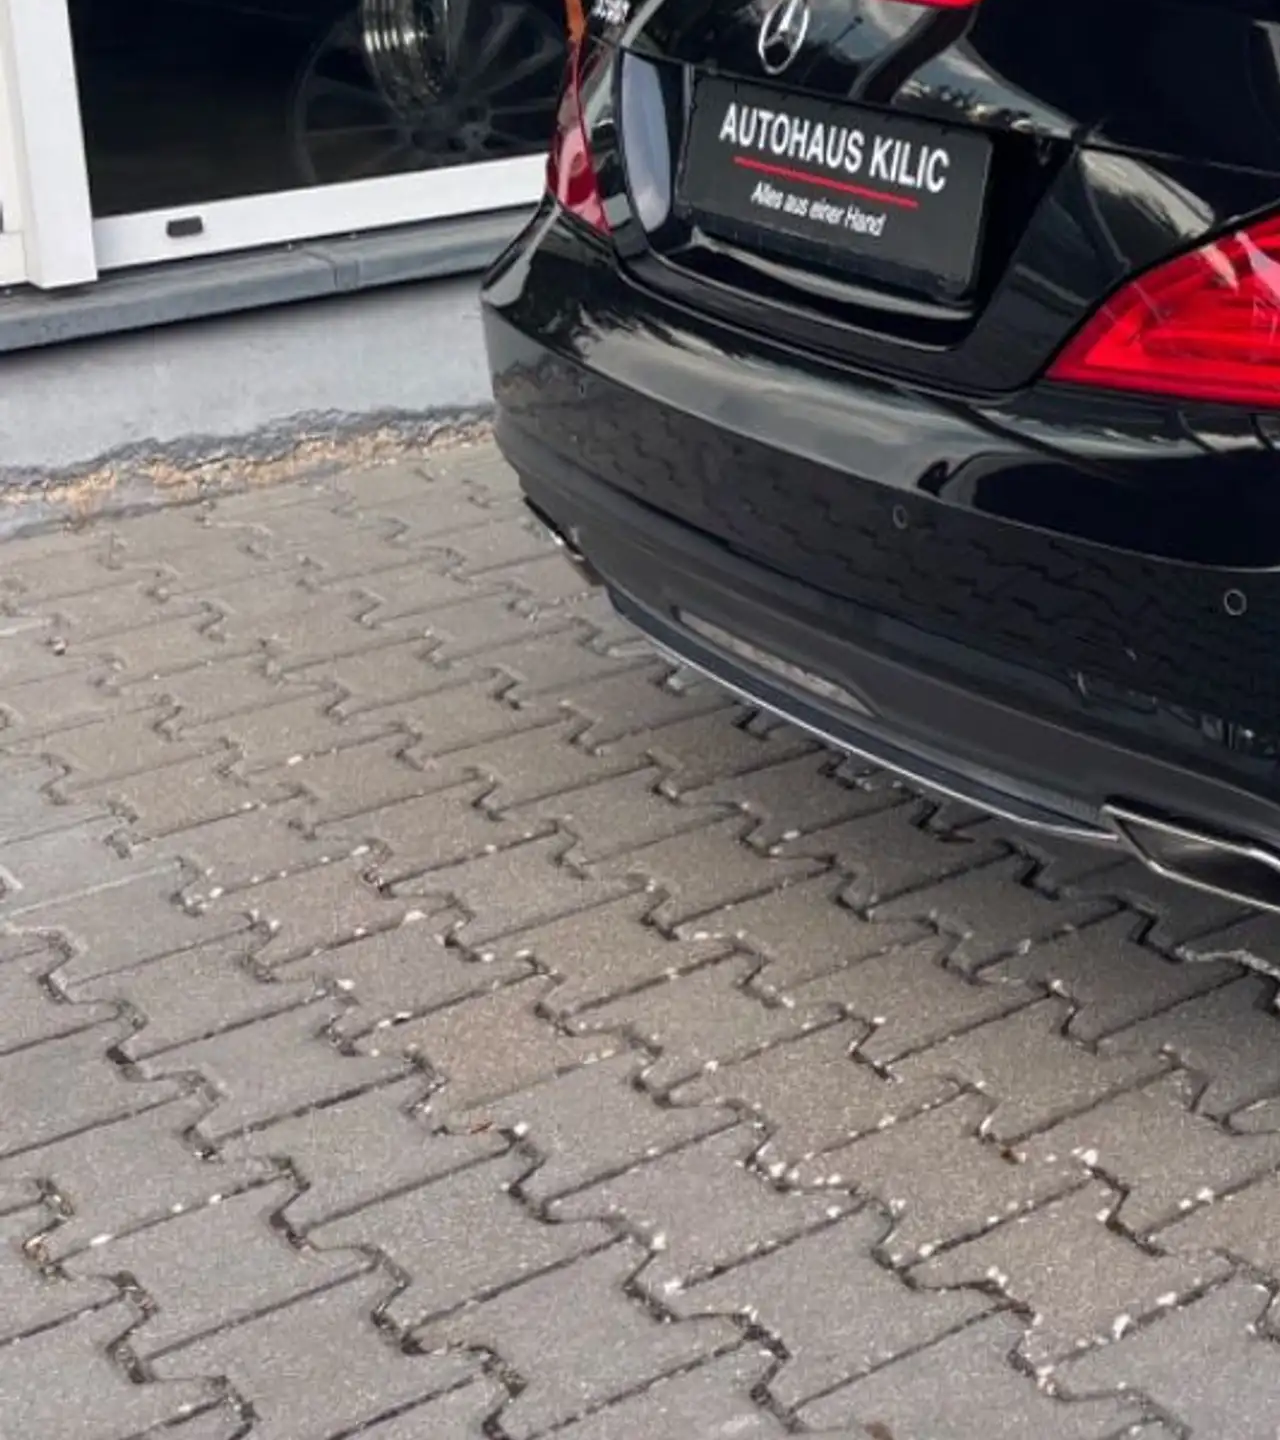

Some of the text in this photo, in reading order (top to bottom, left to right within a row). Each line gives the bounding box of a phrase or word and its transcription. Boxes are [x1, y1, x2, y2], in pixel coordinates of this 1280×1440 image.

[719, 102, 950, 193] AUTOHAUS KILIC
[750, 179, 887, 236] Alles aus einer Hand
